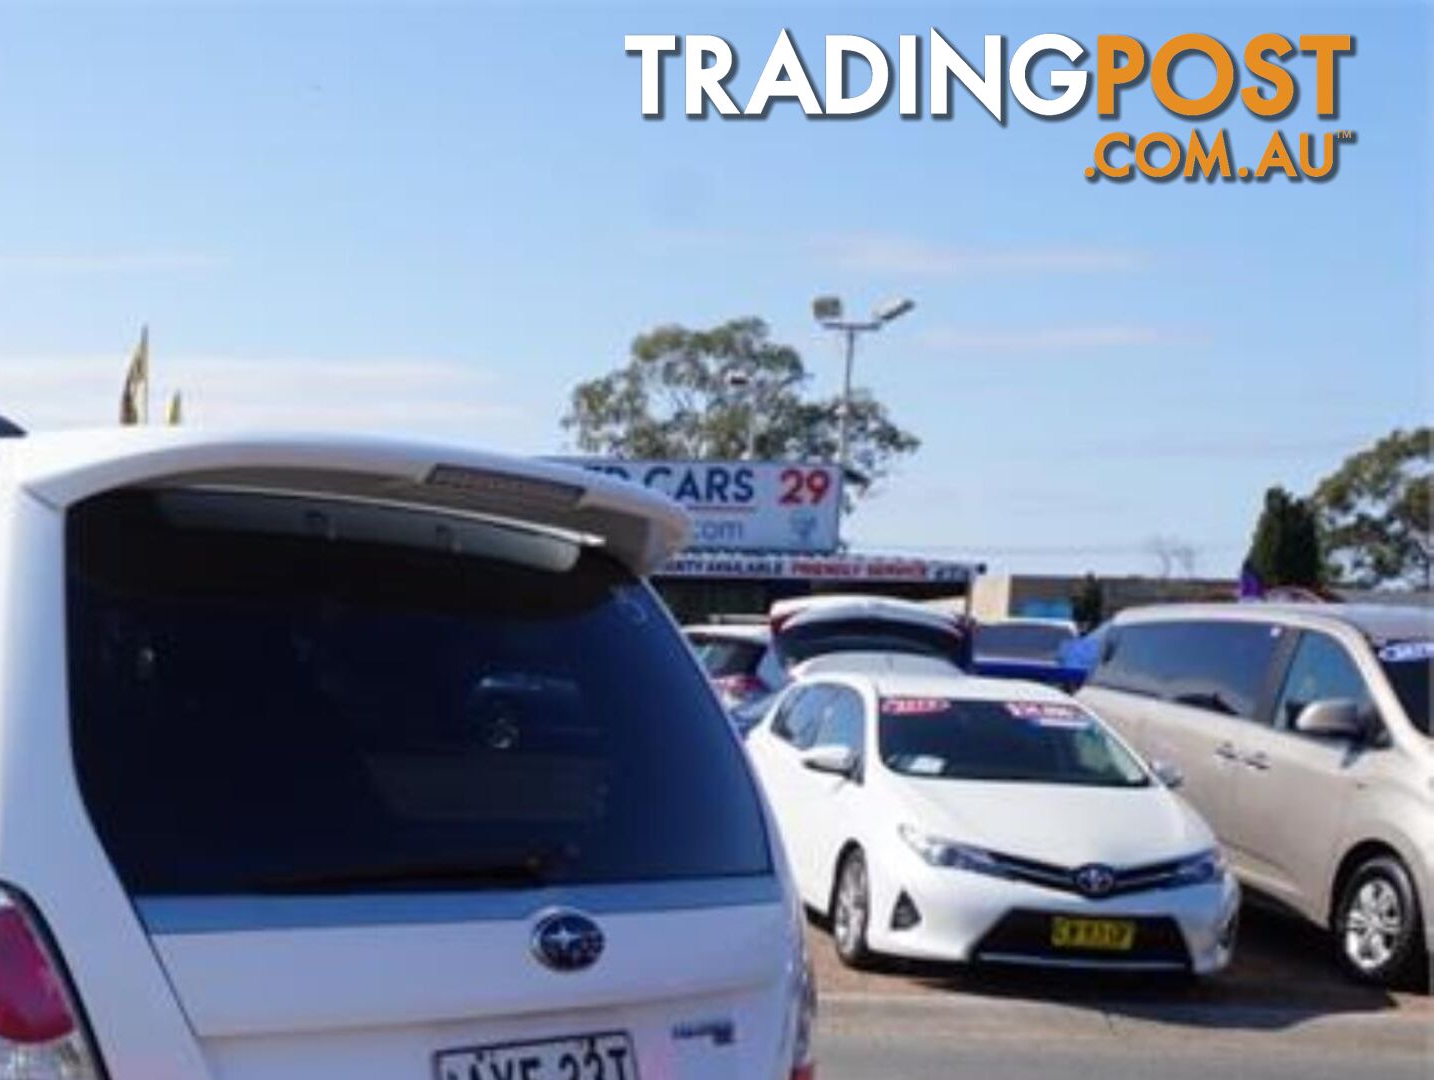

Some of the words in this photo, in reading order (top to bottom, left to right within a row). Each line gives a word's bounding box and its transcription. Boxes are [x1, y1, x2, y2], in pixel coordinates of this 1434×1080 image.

[644, 467, 754, 502] CARS
[778, 469, 830, 505] 29
[792, 562, 862, 578] FRIENDLY
[867, 563, 927, 579] SERVICE
